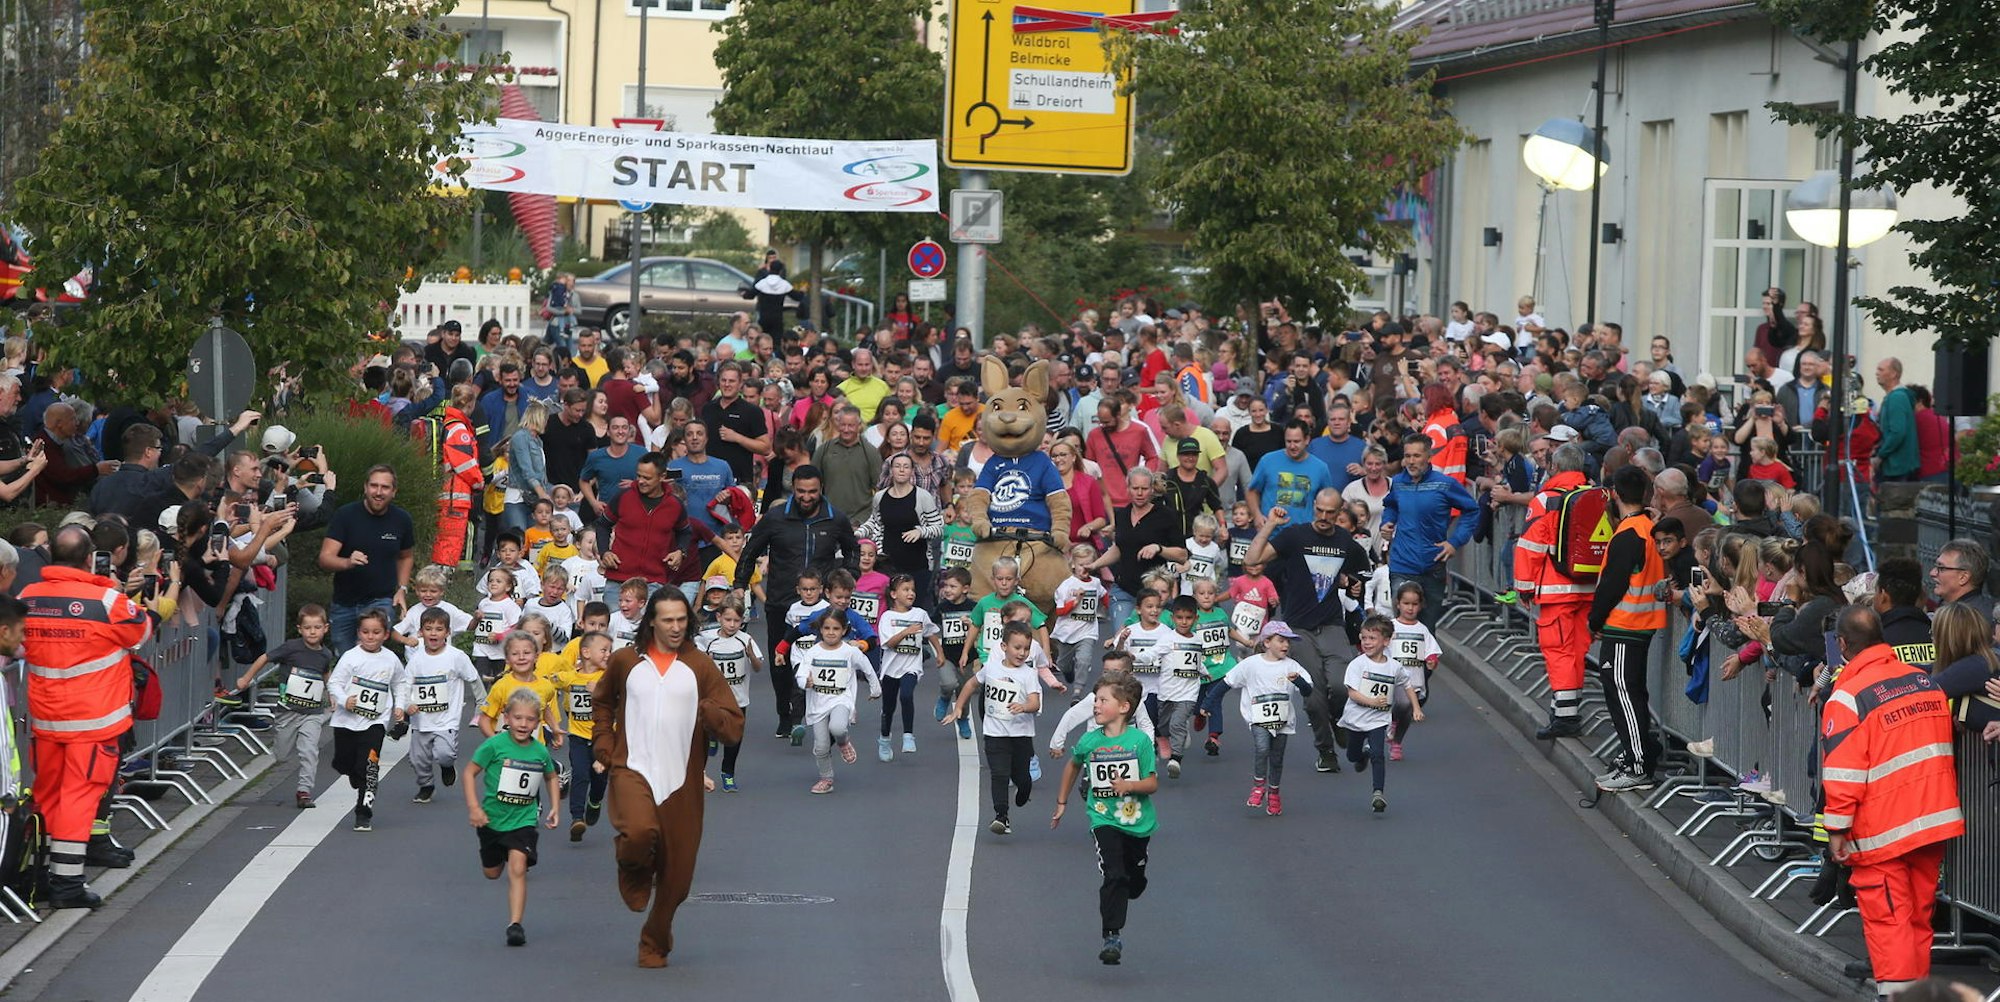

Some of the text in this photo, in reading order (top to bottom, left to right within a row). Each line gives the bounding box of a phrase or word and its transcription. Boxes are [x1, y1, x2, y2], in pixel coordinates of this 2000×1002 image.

[1012, 34, 1070, 49] Waldbröl
[1011, 51, 1071, 66] Belmicke
[1014, 73, 1112, 89] Schullandheim
[1037, 94, 1083, 108] Dreiort
[535, 127, 640, 147] AggerEnergie-
[645, 137, 671, 148] und
[612, 155, 756, 193] START
[950, 545, 972, 558] 650
[1312, 545, 1340, 555] ORIGINALS
[1193, 562, 1208, 574] 47
[1082, 598, 1096, 610] 50
[479, 620, 493, 632] 56
[1234, 613, 1260, 631] 1973
[1203, 628, 1226, 643] 664
[1401, 641, 1418, 654] 65
[1184, 652, 1199, 666] 24
[818, 668, 836, 682] 42
[304, 680, 313, 693] 7
[418, 686, 437, 700] 54
[1370, 683, 1389, 696] 49
[360, 689, 379, 706] 64
[573, 694, 592, 708] 25
[1262, 703, 1280, 717] 52
[1096, 763, 1131, 781] 662
[519, 773, 530, 789] 6
